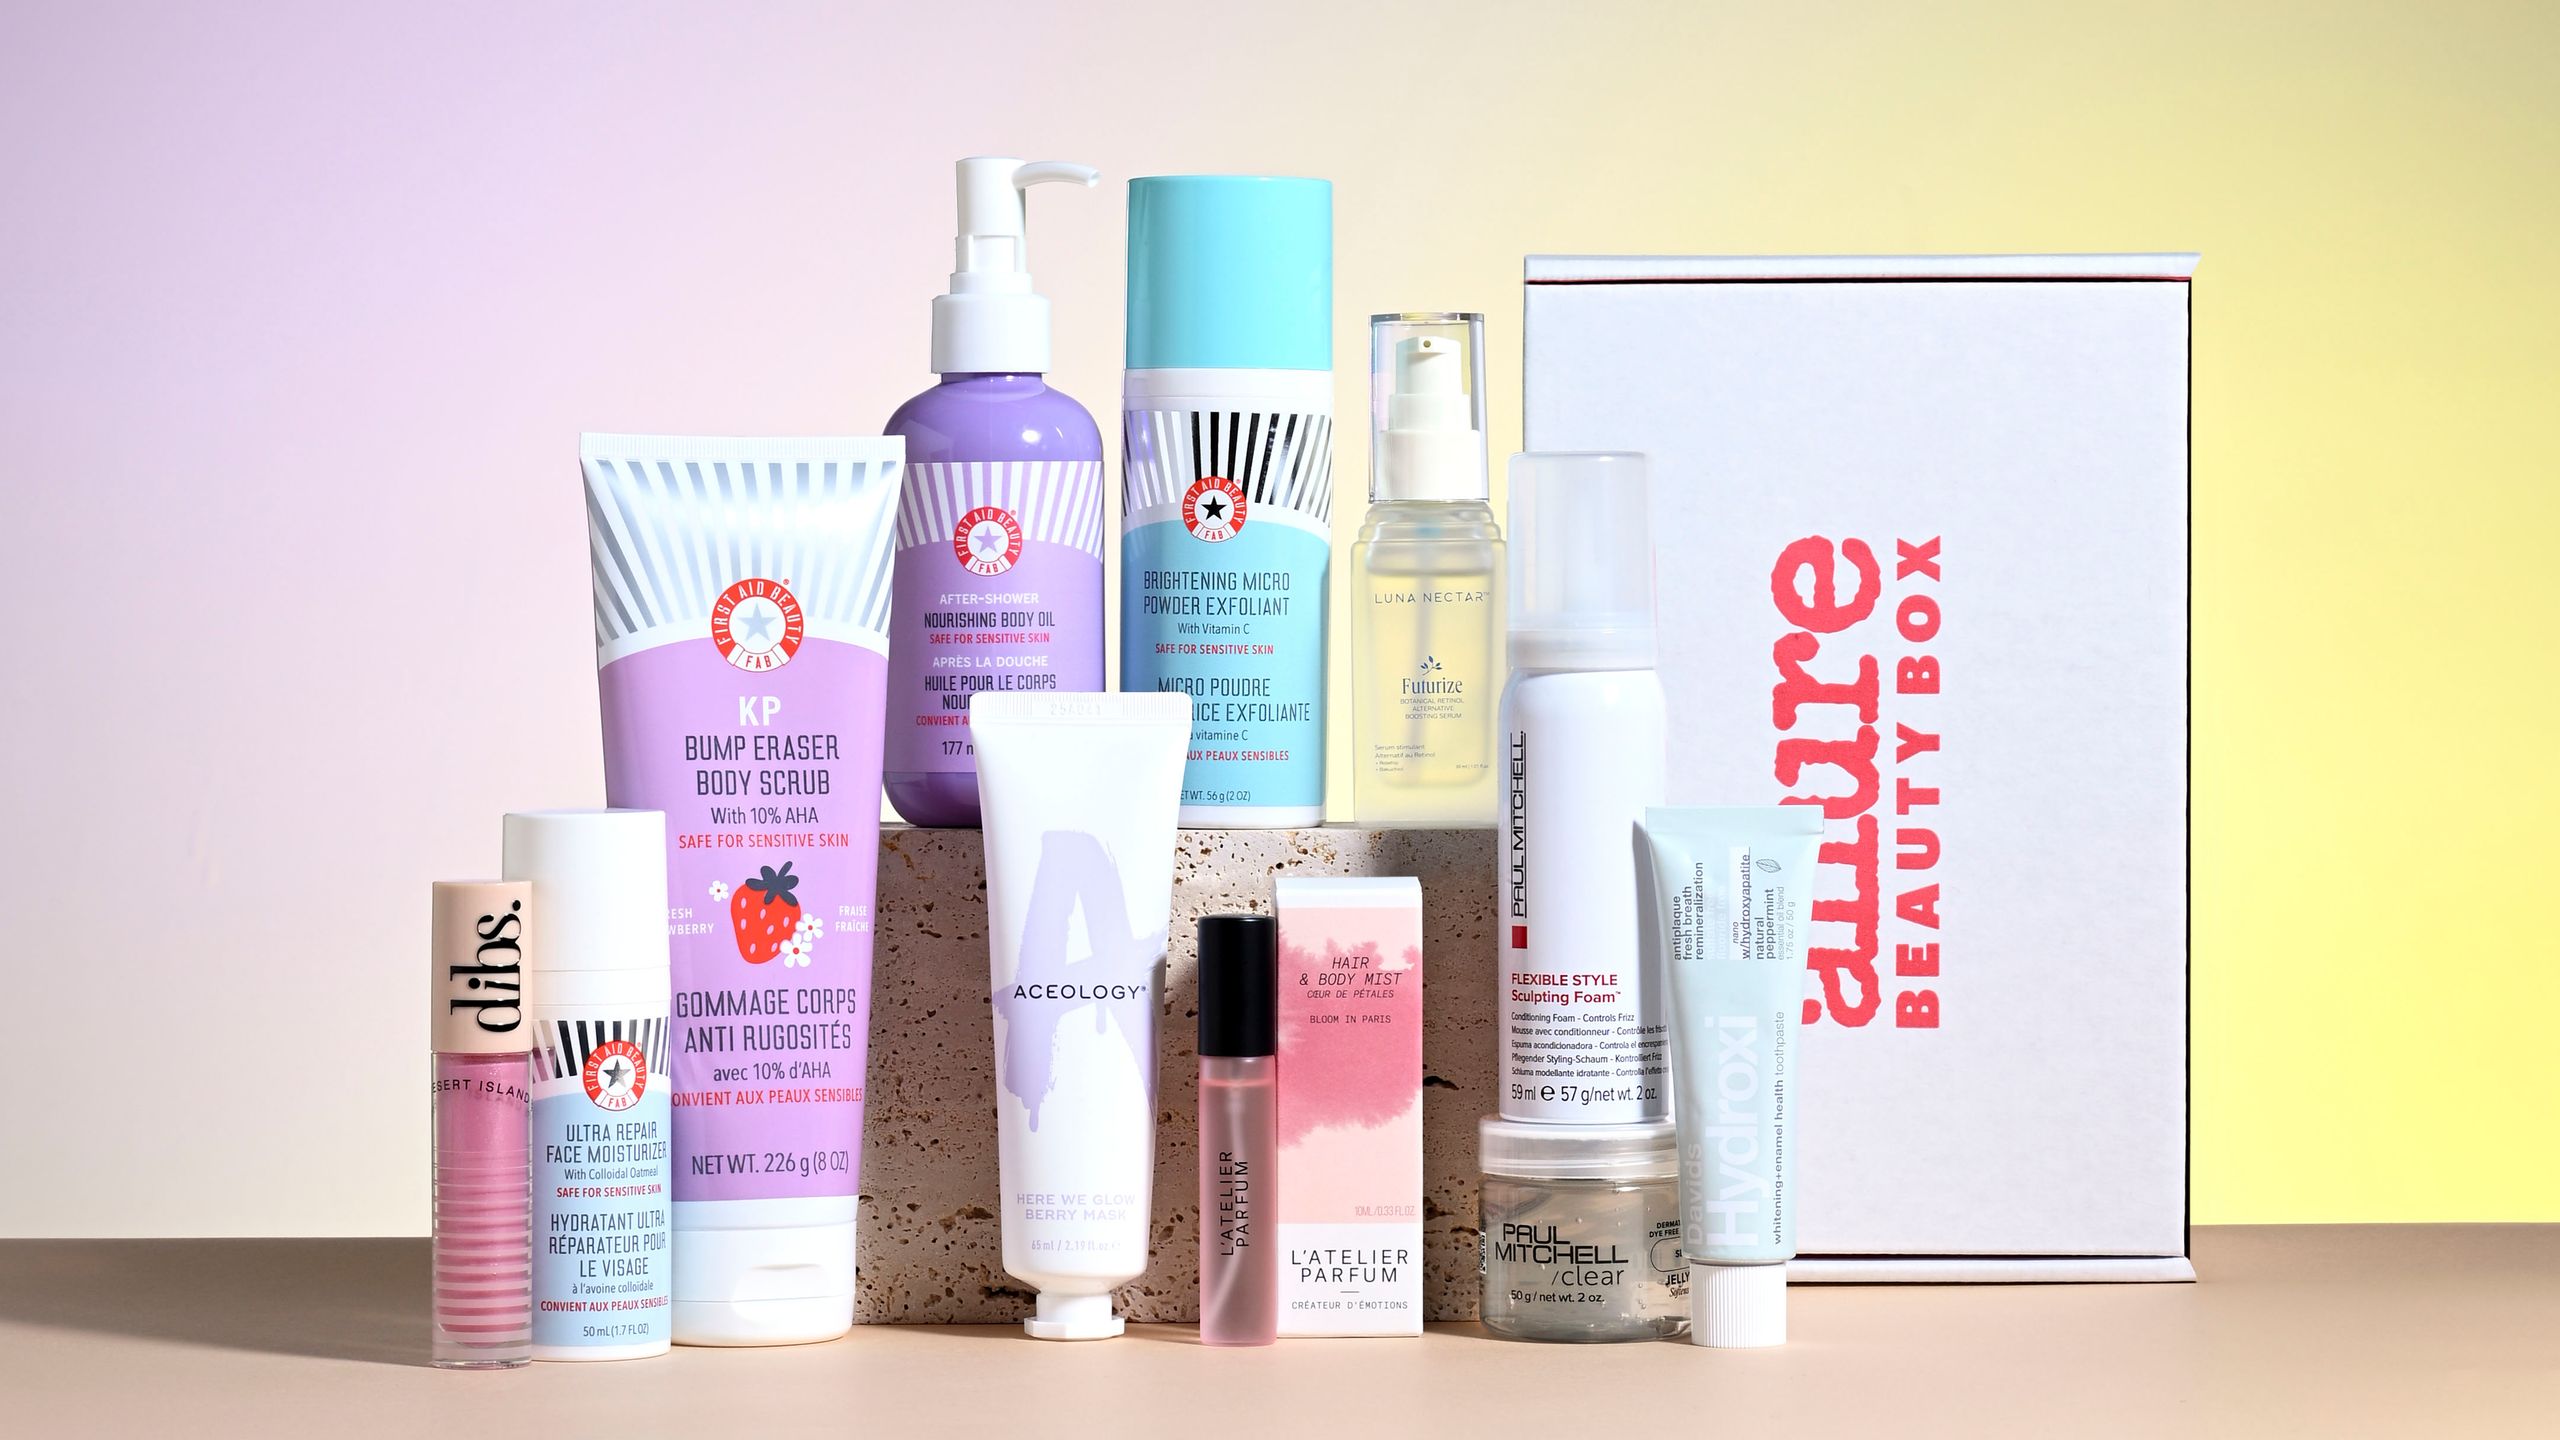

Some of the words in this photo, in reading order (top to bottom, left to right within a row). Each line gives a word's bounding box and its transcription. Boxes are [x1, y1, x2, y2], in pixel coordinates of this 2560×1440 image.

[1184, 488, 1200, 524] FIRST
[1201, 479, 1220, 491] AID
[1224, 481, 1246, 525] BEAUTY
[1204, 530, 1223, 540] FAB
[979, 563, 999, 574] FAB
[1143, 570, 1237, 591] BRIGHTENING
[1243, 572, 1290, 591] MICRO
[939, 593, 1039, 605] AFTER-SHOWER
[1143, 596, 1201, 615] POWDER
[1206, 596, 1290, 616] EXFOLIANT
[1374, 593, 1416, 604] LUNA
[713, 593, 737, 646] FIRST
[738, 581, 765, 599] AID
[769, 585, 802, 646] BEAUTY
[924, 612, 996, 628] NOURISHING
[1001, 611, 1034, 628] BODY
[1038, 611, 1055, 627] OIL
[1896, 535, 1941, 694] BOX
[1177, 622, 1200, 635] With
[1202, 622, 1240, 635] Vitamin
[1155, 643, 1175, 654] SAFE
[1178, 644, 1197, 654] FOR
[1200, 644, 1249, 655] SENSITIVE
[1252, 644, 1274, 655] SKIN
[745, 655, 772, 669] FAB
[933, 654, 971, 668] APRÈS
[975, 656, 992, 667] LA
[996, 655, 1049, 667] DOUCHE
[924, 675, 957, 691] HUILE
[961, 675, 994, 691] POUR
[1017, 674, 1056, 690] CORPS
[1210, 678, 1271, 697] POUDRE
[1402, 677, 1463, 695] Futurize
[1400, 697, 1435, 705] BOTANICAL
[738, 696, 781, 727] KP
[916, 715, 959, 726] CONVIENT
[1226, 703, 1310, 722] EXFOLIANTE
[1439, 712, 1462, 720] SERUM
[685, 735, 746, 761] BUMP
[754, 734, 840, 761] ERASER
[1206, 751, 1238, 761] PEAUX
[1241, 751, 1289, 761] SENSIBLES
[696, 769, 751, 796] BODY
[760, 769, 830, 796] SCRUB
[710, 807, 746, 825] With
[750, 807, 781, 825] 10%
[785, 806, 819, 824] AHA
[679, 834, 712, 849] SAFE
[717, 834, 744, 848] FOR
[749, 833, 814, 848] SENSITIVE
[819, 833, 849, 847] SKIN
[1896, 721, 1941, 1028] BEAUTY
[1513, 855, 1524, 917] PAUL
[839, 905, 867, 917] FRAISE
[1681, 886, 1692, 926] breath
[1693, 862, 1704, 960] remineralization
[1740, 854, 1752, 960] w/hydroxyapatite
[1671, 896, 1683, 960] antiplaque
[1764, 888, 1776, 960] peppermint
[1682, 929, 1692, 960] fresh
[1754, 917, 1764, 960] natural
[1331, 956, 1370, 970] HAIR
[1318, 972, 1356, 986] BODY
[1364, 972, 1403, 986] MIST
[1511, 973, 1568, 986] FLEXIBLE
[1572, 974, 1618, 986] STYLE
[1353, 987, 1394, 999] PÉTALES
[1511, 989, 1569, 1006] Sculpting
[676, 989, 790, 1018] GOMMAGE
[797, 988, 856, 1015] CORPS
[1309, 1015, 1339, 1024] BLOOM
[1345, 1015, 1357, 1024] IN
[1362, 1015, 1391, 1024] PARIS
[1511, 1012, 1551, 1024] Conditioning
[1552, 1013, 1576, 1023] Foam
[1583, 1013, 1616, 1023] Controls
[1618, 1013, 1635, 1022] Frizz
[685, 1026, 734, 1054] ANTI
[743, 1019, 851, 1051] RUGOSITÉS
[1774, 1011, 1786, 1076] toothpaste
[713, 1068, 748, 1082] avec
[753, 1062, 785, 1080] 10%
[789, 1061, 831, 1079] d'AHA
[432, 1079, 471, 1093] ESERT
[480, 1080, 530, 1103] ISLAND
[735, 1090, 765, 1105] AUX
[769, 1089, 811, 1104] PEAUX
[814, 1087, 863, 1103] SENSIBLES
[1561, 1086, 1578, 1101] 57
[1581, 1086, 1614, 1106] g/net
[1774, 1079, 1783, 1120] health
[608, 1097, 627, 1108] FAB
[566, 1123, 611, 1142] ULTRA
[616, 1121, 657, 1142] REPAIR
[1705, 1015, 1770, 1247] Hydroxi
[546, 1145, 582, 1163] FACE
[587, 1141, 667, 1163] MOISTURIZER
[564, 1168, 586, 1180] With
[589, 1167, 628, 1180] Colloidal
[630, 1165, 659, 1178] Oatmeal
[692, 1154, 723, 1176] NET
[727, 1153, 759, 1174] WT.
[764, 1152, 796, 1173] 226
[557, 1187, 580, 1198] SAFE
[582, 1187, 601, 1198] FOR
[604, 1185, 646, 1197] SENSITIVE
[647, 1183, 662, 1194] SKIN
[1017, 1193, 1055, 1205] HERE
[1061, 1194, 1087, 1205] WE
[1092, 1194, 1136, 1206] GLOW
[1687, 1143, 1703, 1246] Davids
[1219, 1150, 1234, 1257] L'ATELIER
[1236, 1160, 1249, 1248] PARFUM
[551, 1212, 634, 1232] HYDRATANT
[637, 1209, 665, 1230] ULTRA
[1025, 1209, 1077, 1220] BERRY
[1083, 1209, 1127, 1221] MASK
[1503, 1223, 1571, 1245] PAUL
[1649, 1229, 1663, 1238] DYE
[1664, 1228, 1680, 1237] FREE
[549, 1234, 639, 1255] RÉPARATEUR
[643, 1231, 666, 1252] POUR
[1291, 1249, 1409, 1265] L'ATELIER
[1495, 1242, 1629, 1264] MITCHELL
[580, 1260, 597, 1278] LE
[602, 1257, 649, 1278] VISAGE
[1301, 1267, 1397, 1283] PARFUM
[580, 1283, 616, 1295] l'avoine
[618, 1280, 654, 1293] colloïdale
[1665, 1271, 1690, 1286] JELLY
[1291, 1300, 1341, 1310] CRÉATEUR
[1511, 1290, 1523, 1300] 50
[1539, 1292, 1556, 1303] net
[1558, 1293, 1575, 1303] wt.
[1588, 1294, 1605, 1303] oz.
